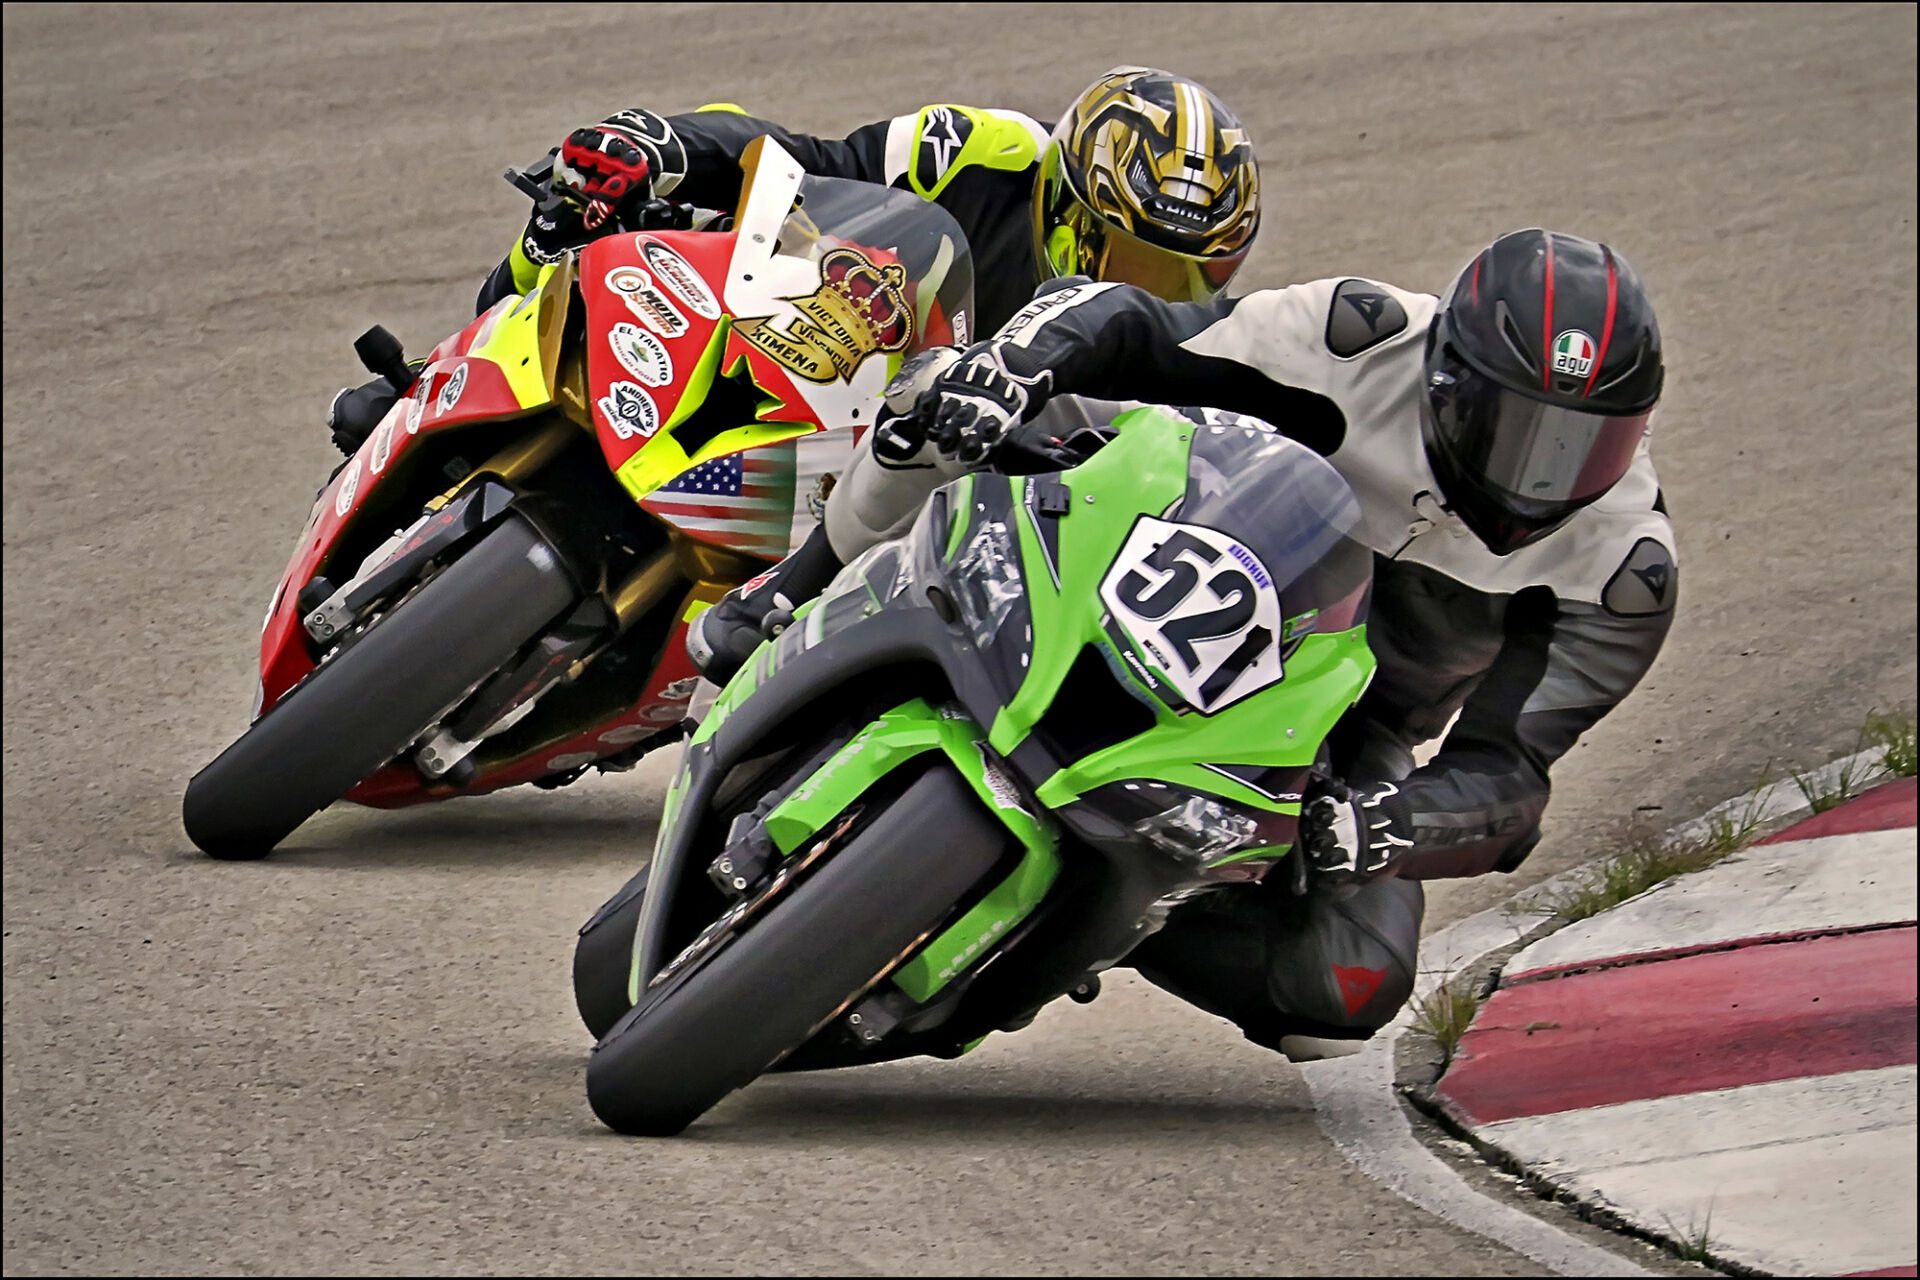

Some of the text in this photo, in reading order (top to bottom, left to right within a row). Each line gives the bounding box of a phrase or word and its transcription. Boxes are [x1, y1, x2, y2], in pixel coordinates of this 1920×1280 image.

[640, 290, 683, 326] MOTO
[807, 301, 862, 358] VICTORIA
[618, 326, 668, 381] EL TAPATIO
[750, 328, 819, 373] XIMENA
[1557, 354, 1590, 373] agv
[620, 385, 654, 428] ANDREW'S
[1116, 529, 1273, 709] 521
